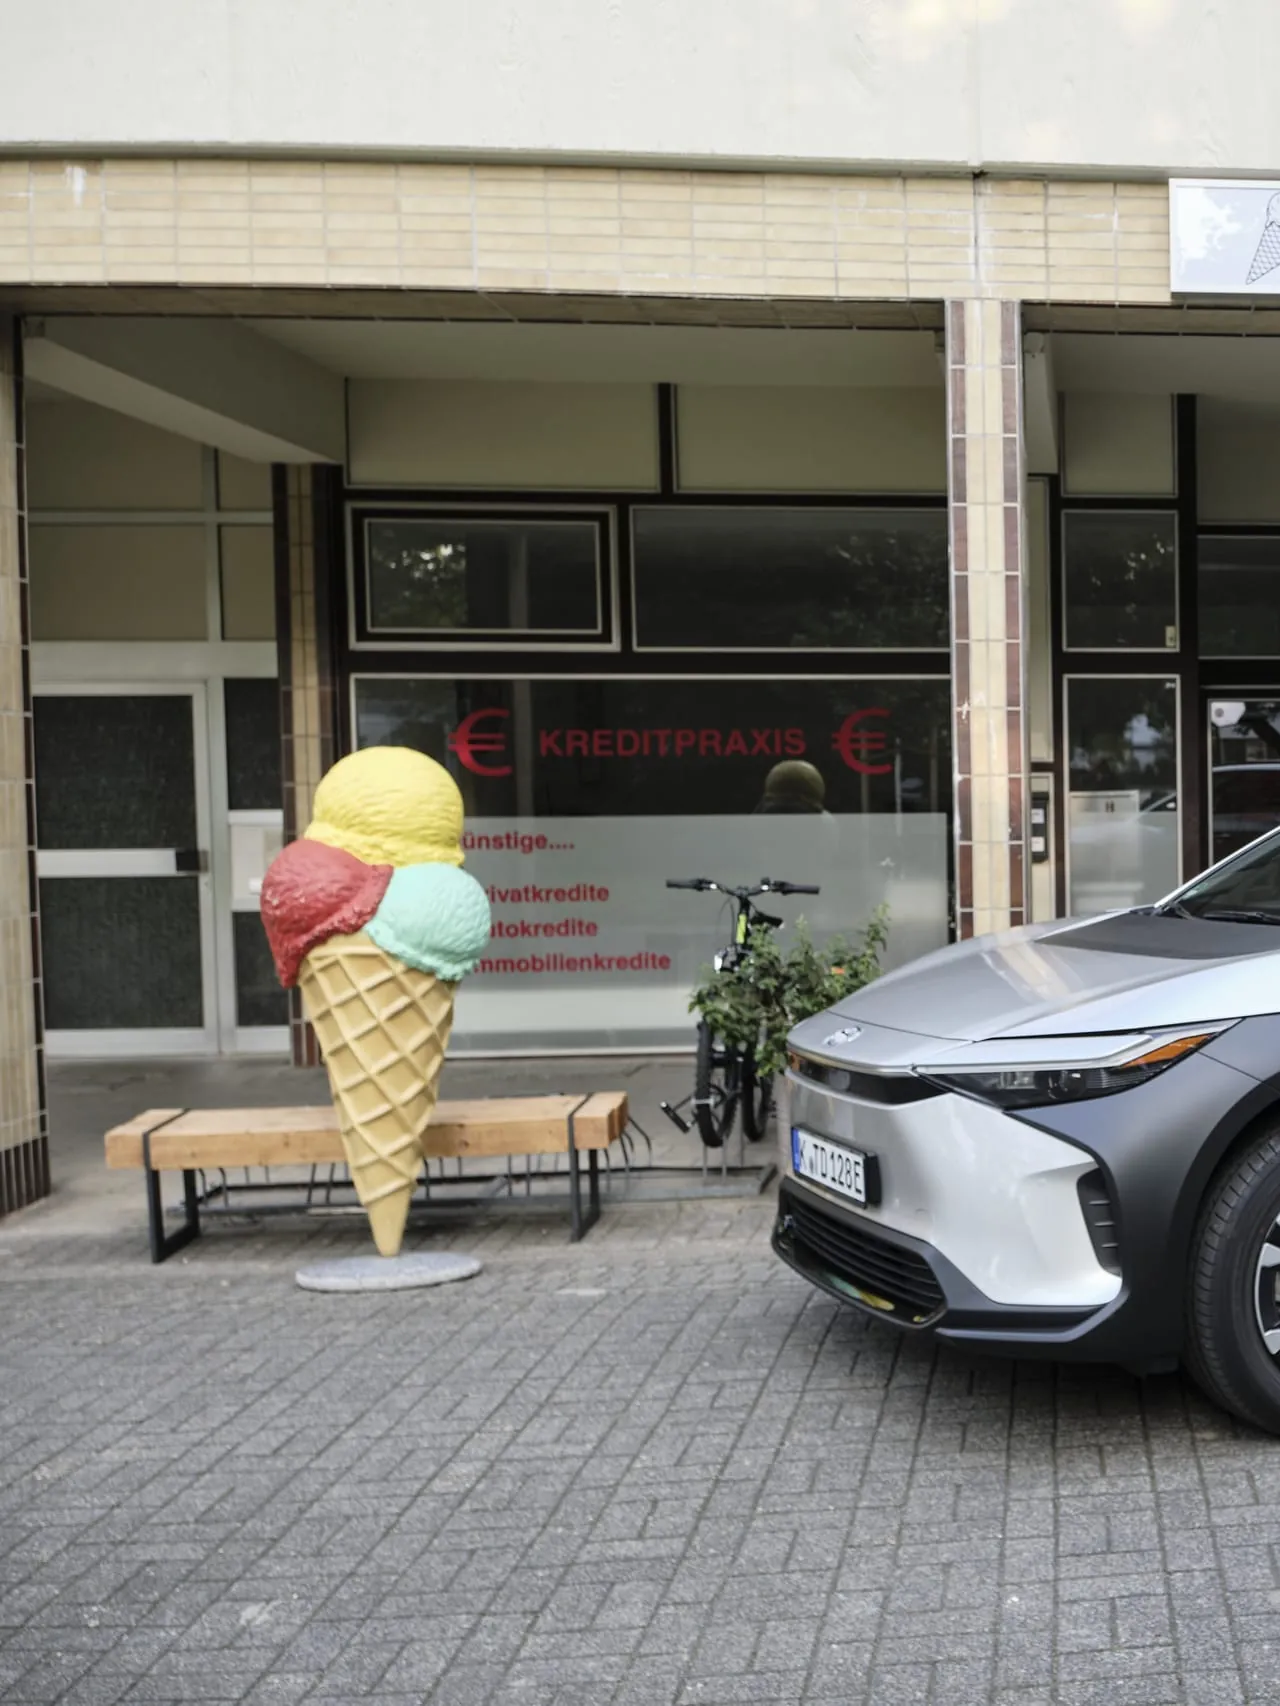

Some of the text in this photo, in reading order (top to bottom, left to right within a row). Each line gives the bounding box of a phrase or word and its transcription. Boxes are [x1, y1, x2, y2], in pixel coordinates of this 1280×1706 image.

[448, 707, 893, 777] € KREDITPRAXIS €
[462, 831, 575, 854] ünstige....
[486, 884, 609, 903] ivatkredite
[473, 951, 671, 974] mmobilienkredite
